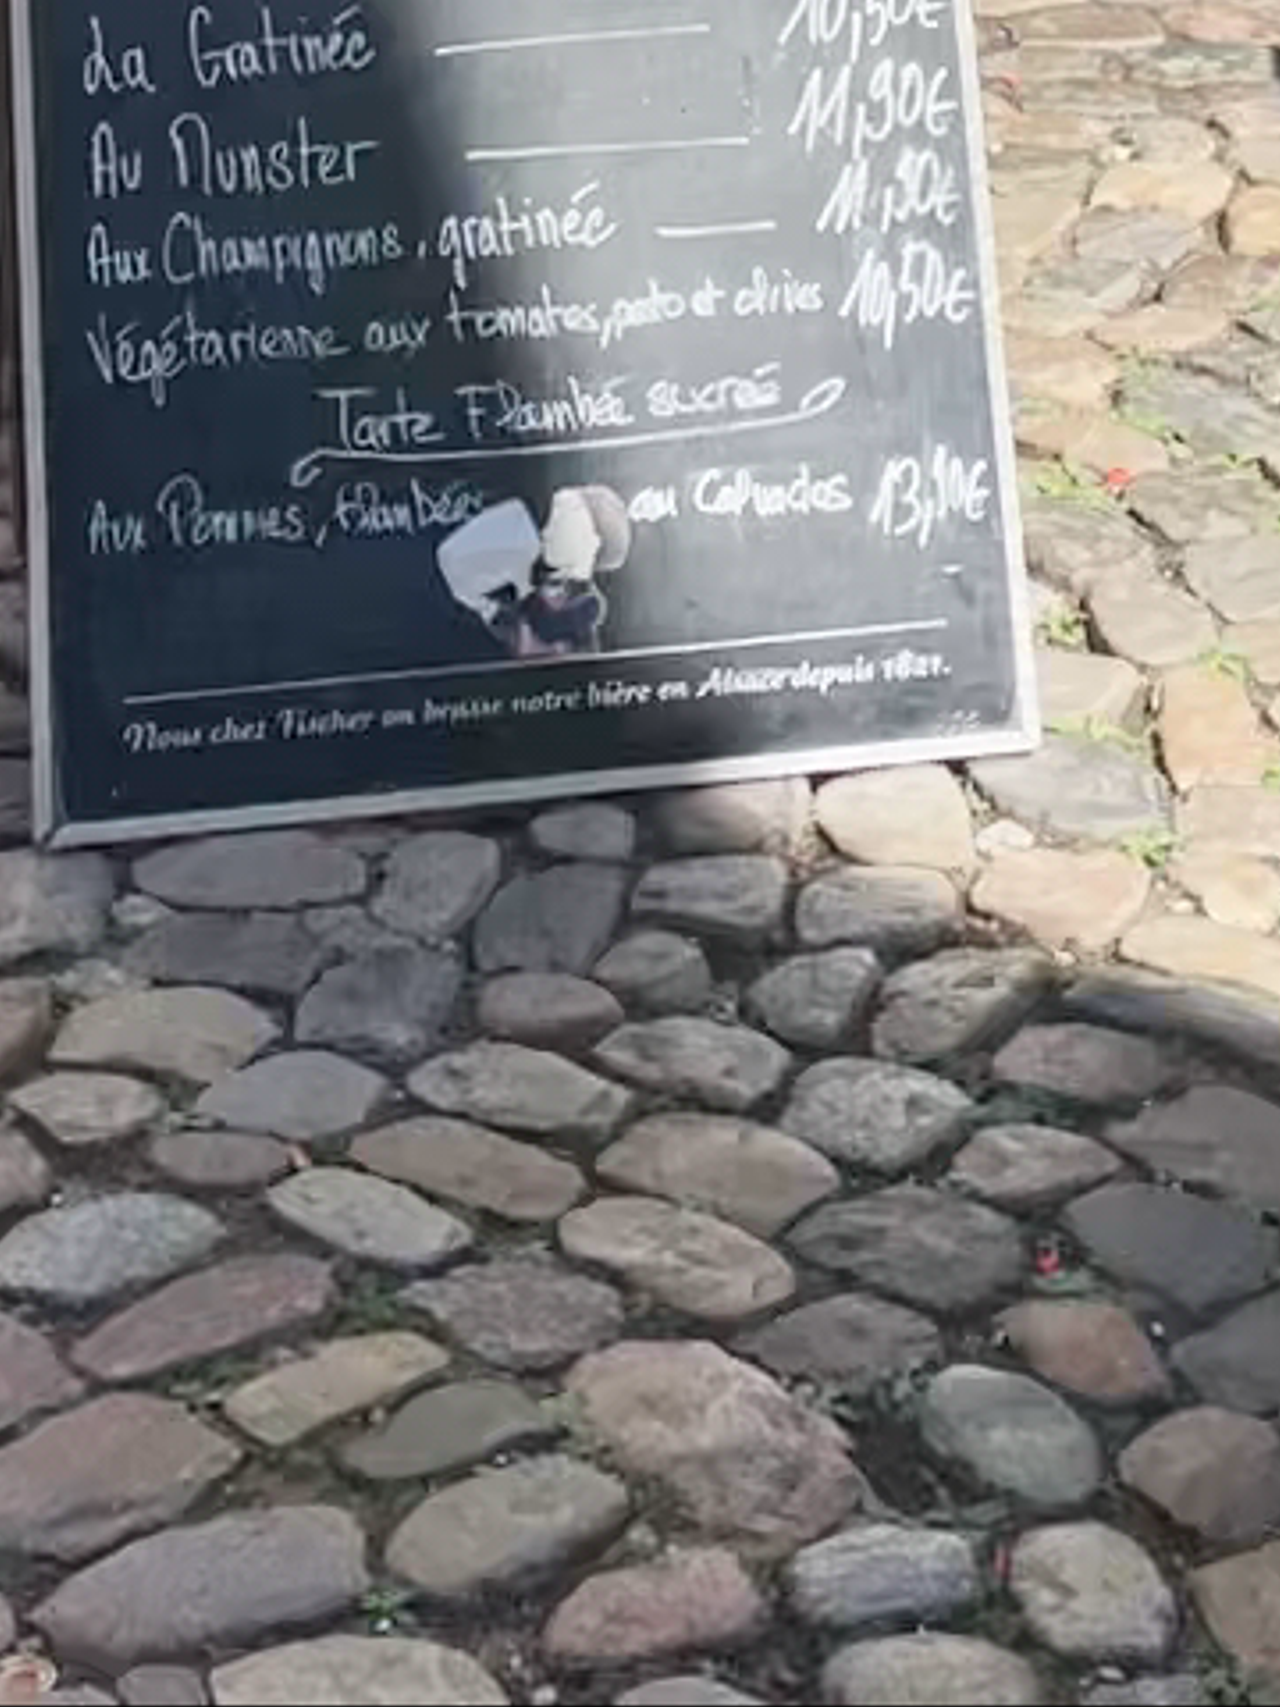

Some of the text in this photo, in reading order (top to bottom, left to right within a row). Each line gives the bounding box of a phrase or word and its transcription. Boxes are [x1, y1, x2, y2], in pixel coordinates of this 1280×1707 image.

[92, 122, 142, 198] Au
[786, 58, 958, 160] 11,90€
[123, 722, 202, 753] Nous
[381, 709, 415, 728] on
[656, 681, 689, 701] en
